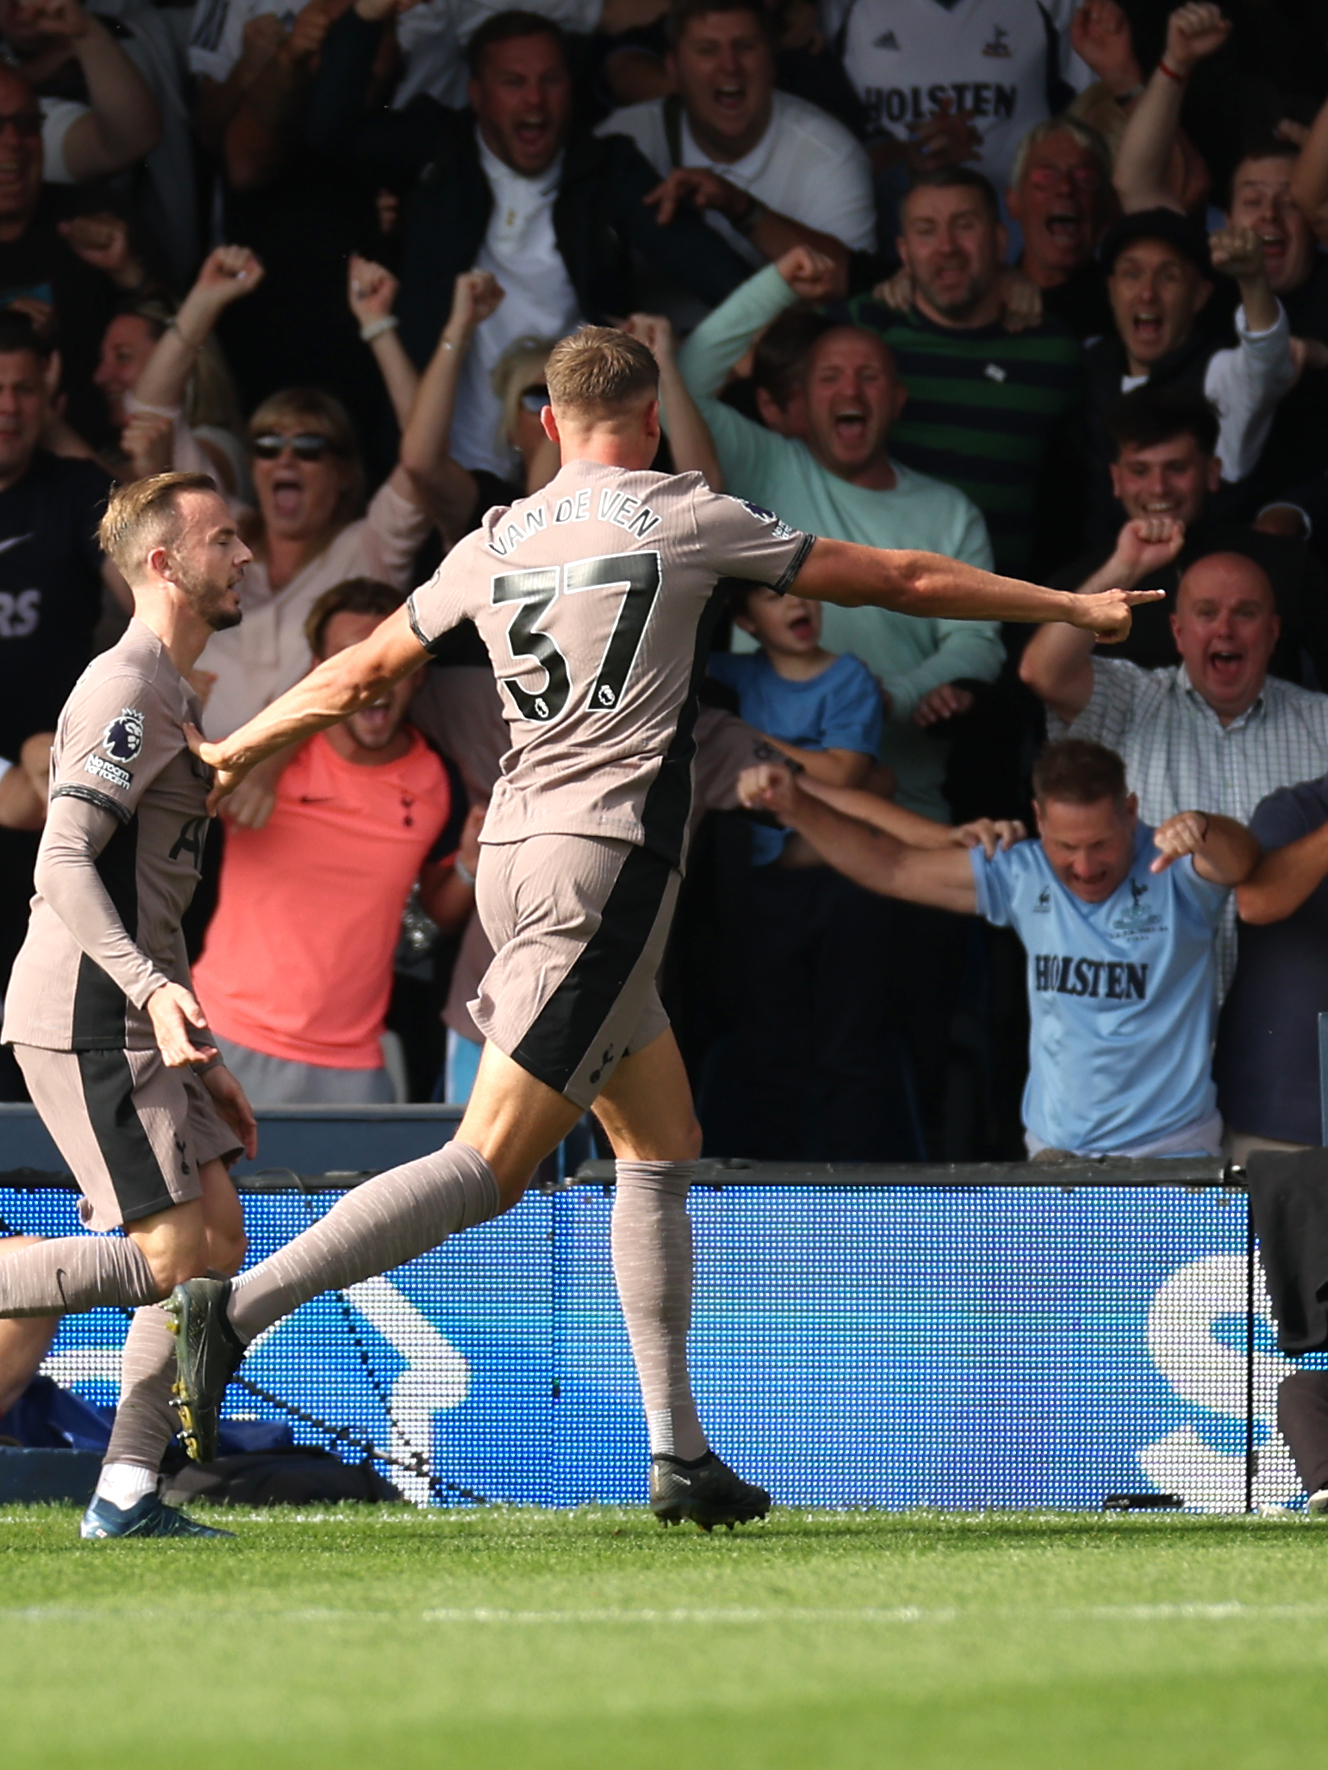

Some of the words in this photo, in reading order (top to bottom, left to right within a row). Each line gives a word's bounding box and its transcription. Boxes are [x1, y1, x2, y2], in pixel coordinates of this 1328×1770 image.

[487, 506, 547, 556] VAN
[553, 488, 592, 524] DE
[598, 487, 662, 540] VEN
[490, 550, 662, 725] 37
[87, 753, 104, 768] No
[103, 761, 130, 781] room
[1035, 954, 1149, 1000] HOLSTEN
